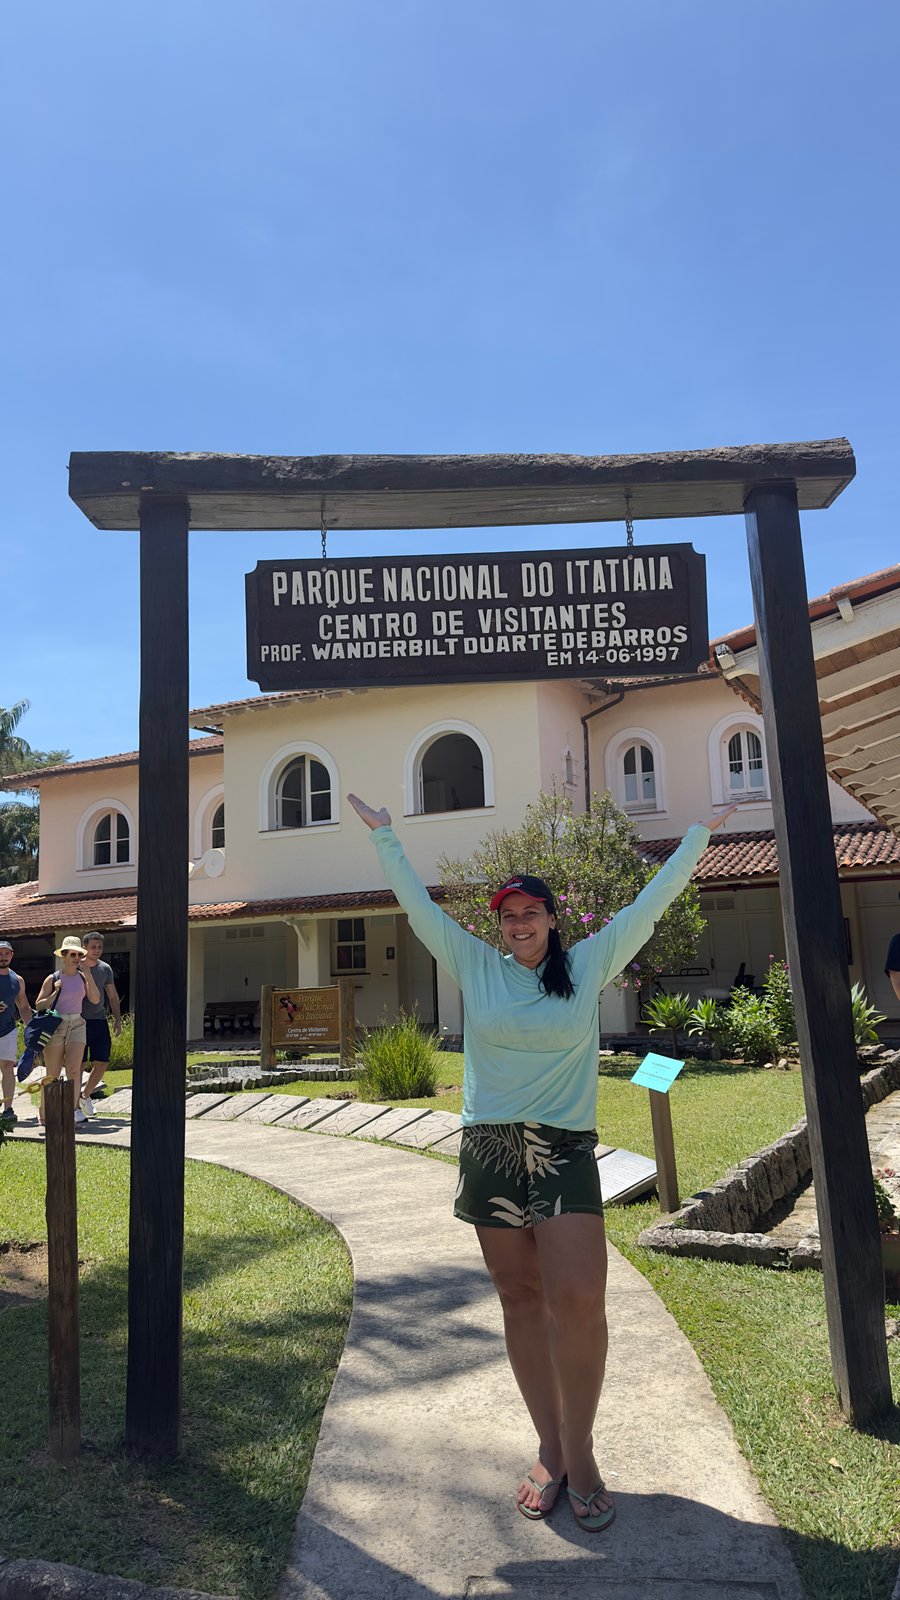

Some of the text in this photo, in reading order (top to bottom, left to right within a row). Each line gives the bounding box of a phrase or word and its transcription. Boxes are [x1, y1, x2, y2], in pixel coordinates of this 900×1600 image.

[272, 556, 673, 608] PARQUE NACIONAL DO ITATIAIA
[319, 602, 626, 640] CENTRO DE VISITANTES
[261, 625, 688, 662] PROF. WANDERBILT DUARTE DE BARROS
[547, 646, 680, 666] EM 14-06-1997
